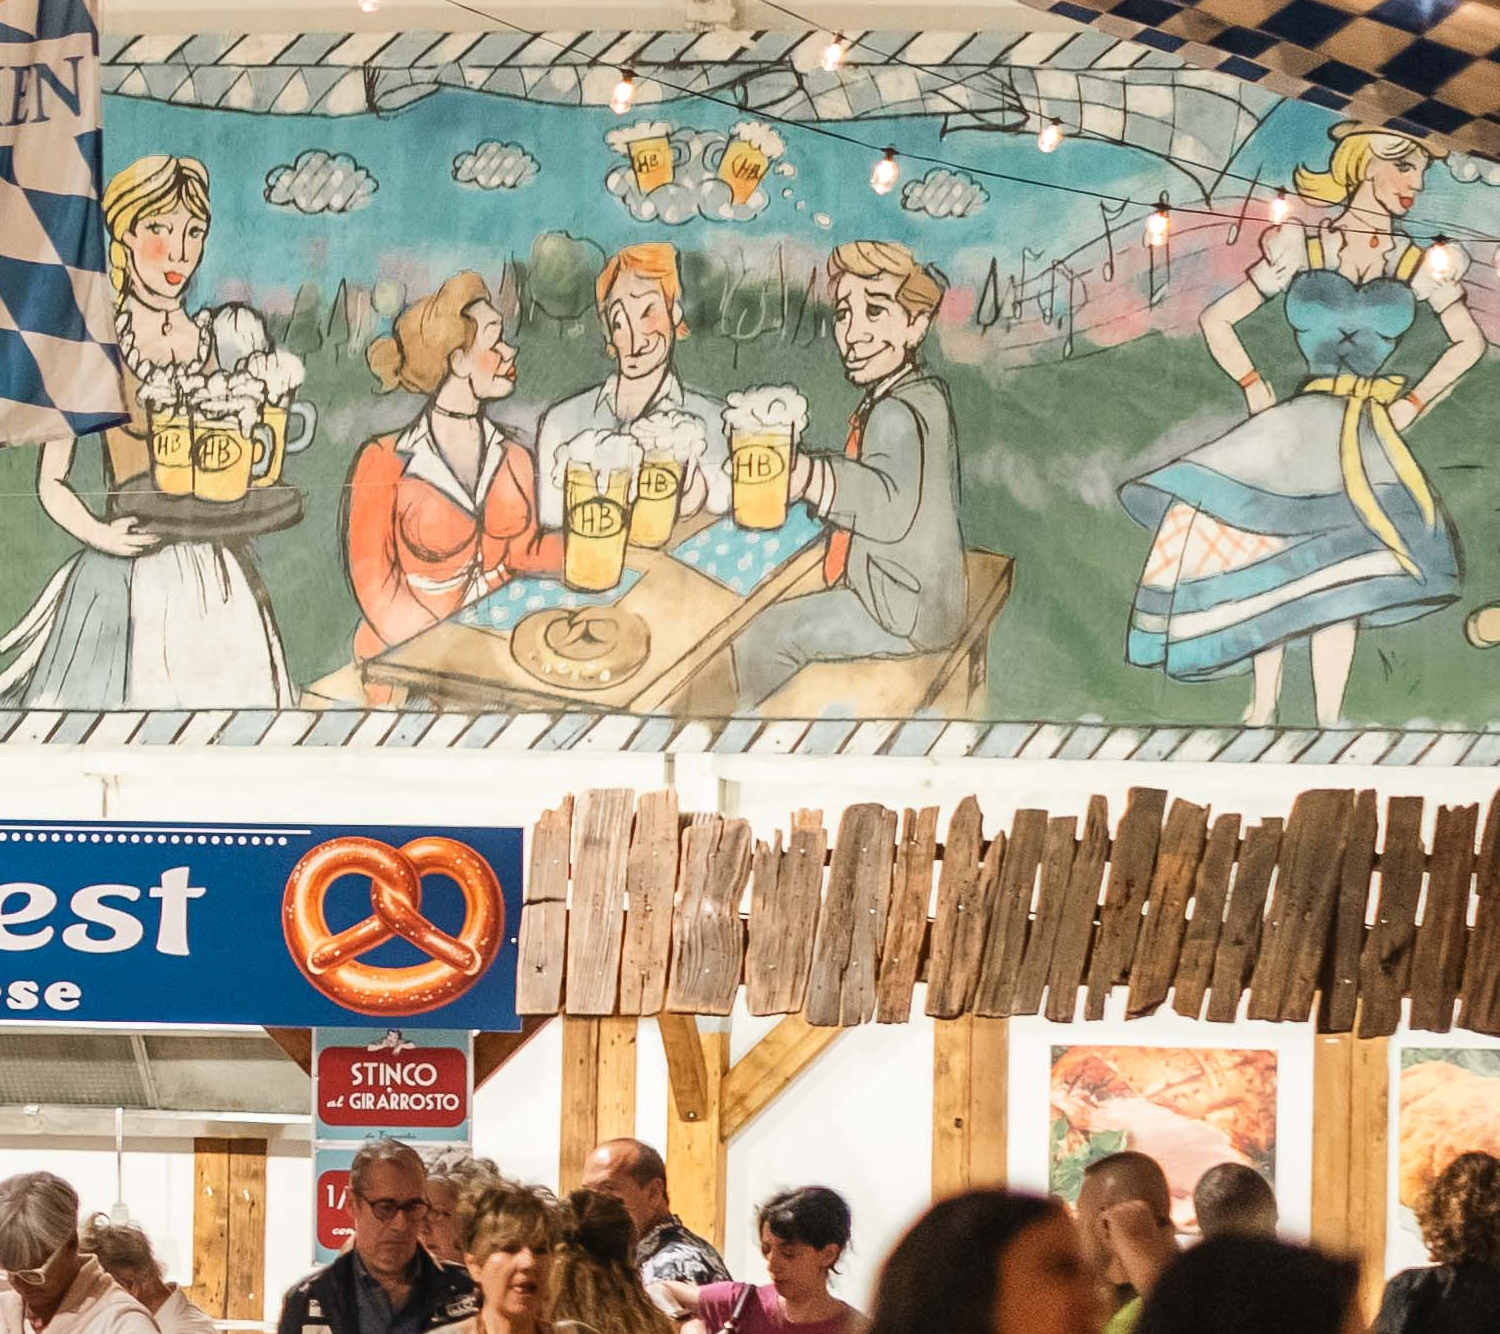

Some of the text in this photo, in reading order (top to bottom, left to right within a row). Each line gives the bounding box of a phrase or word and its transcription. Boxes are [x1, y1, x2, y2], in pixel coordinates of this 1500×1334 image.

[204, 436, 231, 467] HB
[734, 454, 772, 482] HB
[581, 505, 614, 533] HB
[350, 1062, 438, 1087] STINCO
[348, 1092, 460, 1111] GIRARROSTO
[326, 1184, 350, 1211] 1/
